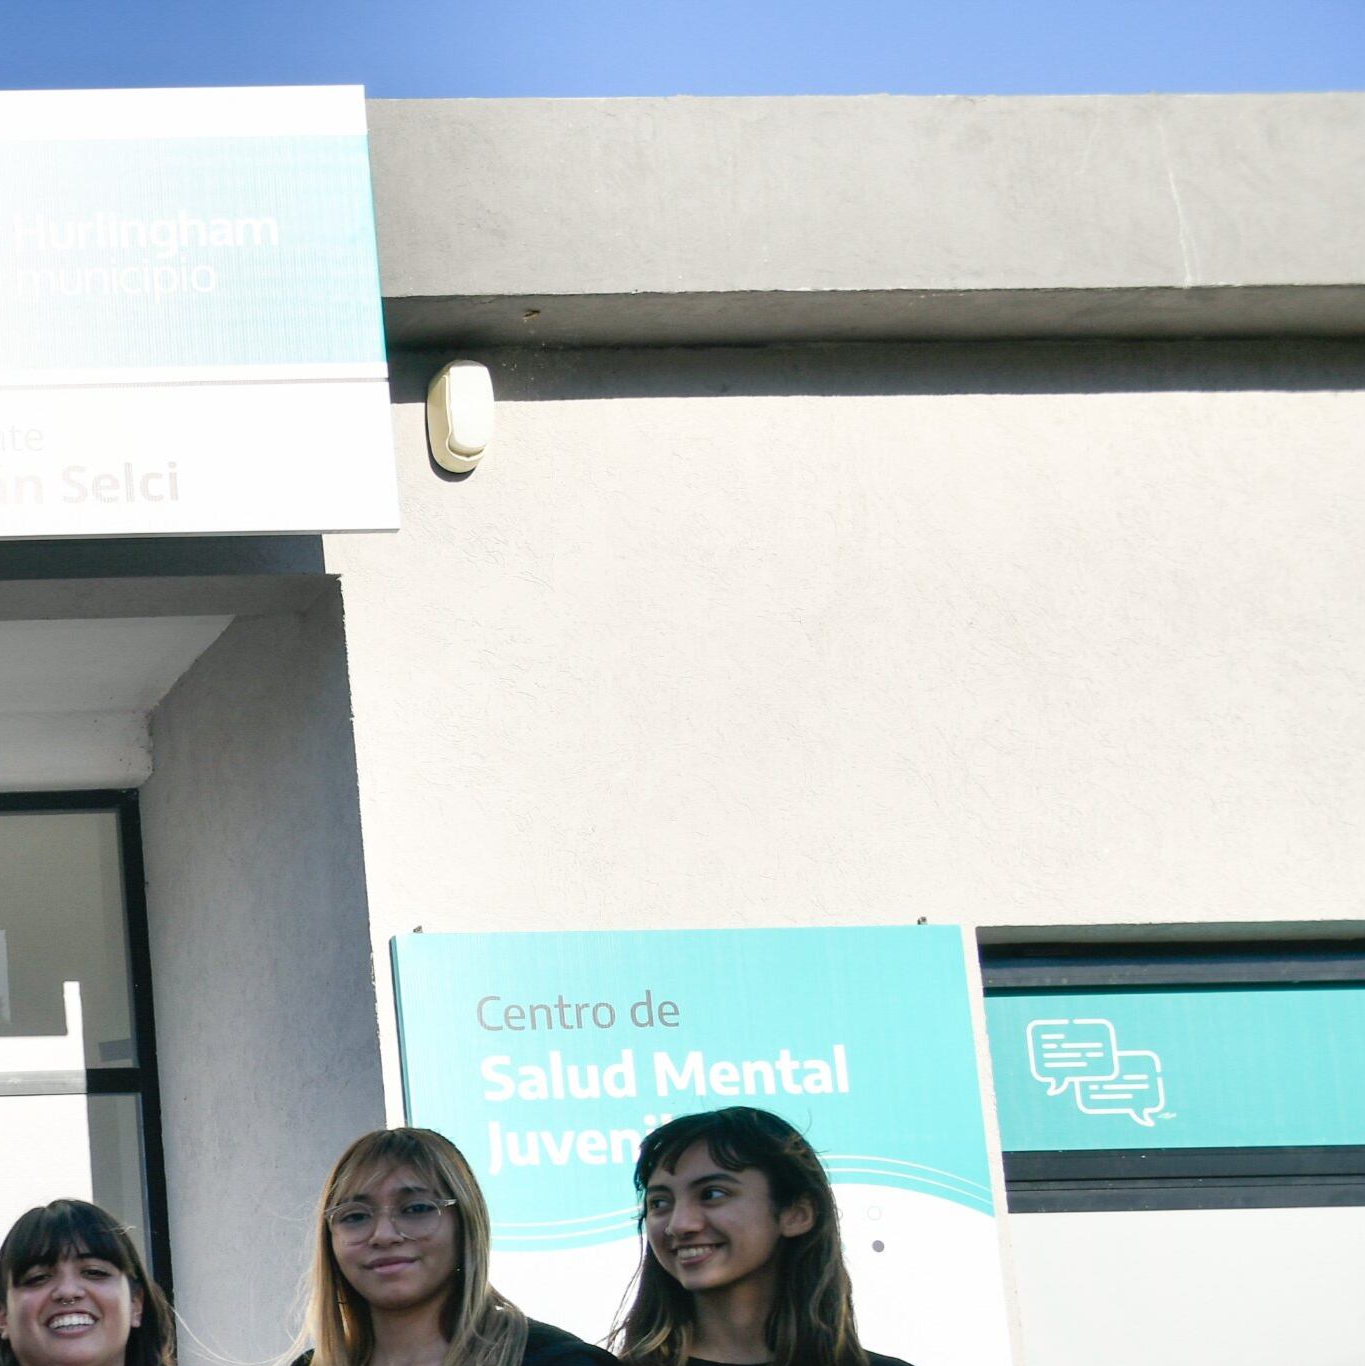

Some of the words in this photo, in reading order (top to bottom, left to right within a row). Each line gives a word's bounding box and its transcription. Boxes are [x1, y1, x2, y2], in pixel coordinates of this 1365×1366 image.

[12, 208, 279, 258] Hurlingham
[17, 255, 217, 302] municipio
[60, 460, 181, 504] Selci
[476, 994, 616, 1031] Centro
[630, 989, 681, 1028] de
[480, 1049, 637, 1102] Salud
[653, 1044, 850, 1097] Mental
